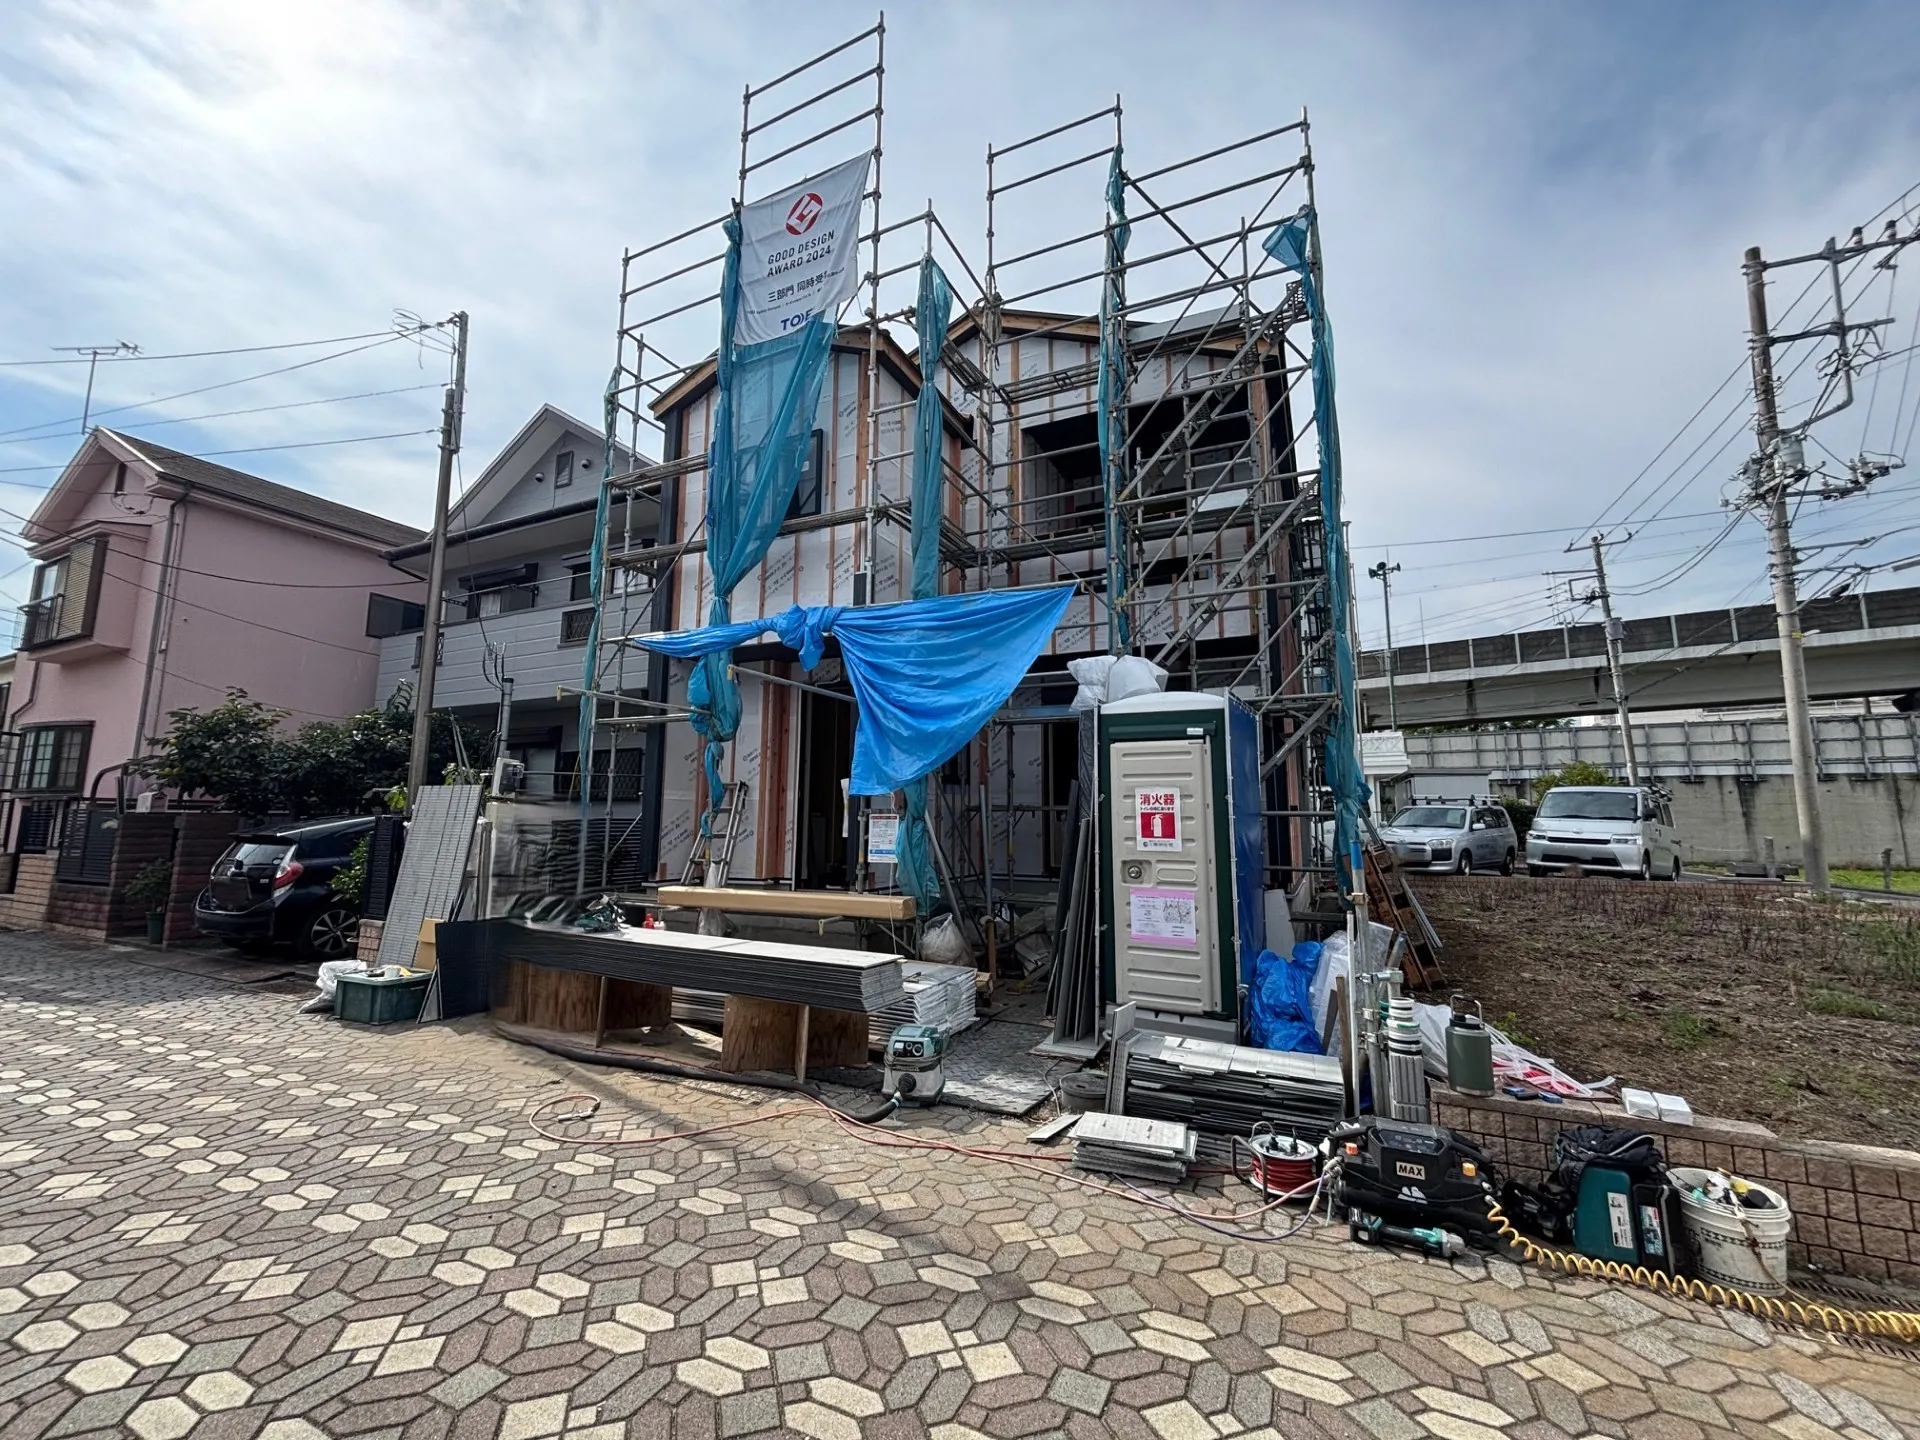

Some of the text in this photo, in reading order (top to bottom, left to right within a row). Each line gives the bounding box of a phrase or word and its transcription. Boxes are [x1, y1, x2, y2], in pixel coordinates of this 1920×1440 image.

[768, 230, 835, 265] GOOD DESIGN
[766, 245, 831, 277] AWARD 2024
[768, 285, 795, 302] 三部門
[1140, 793, 1175, 806] 消火器
[1398, 1164, 1423, 1177] MAX
